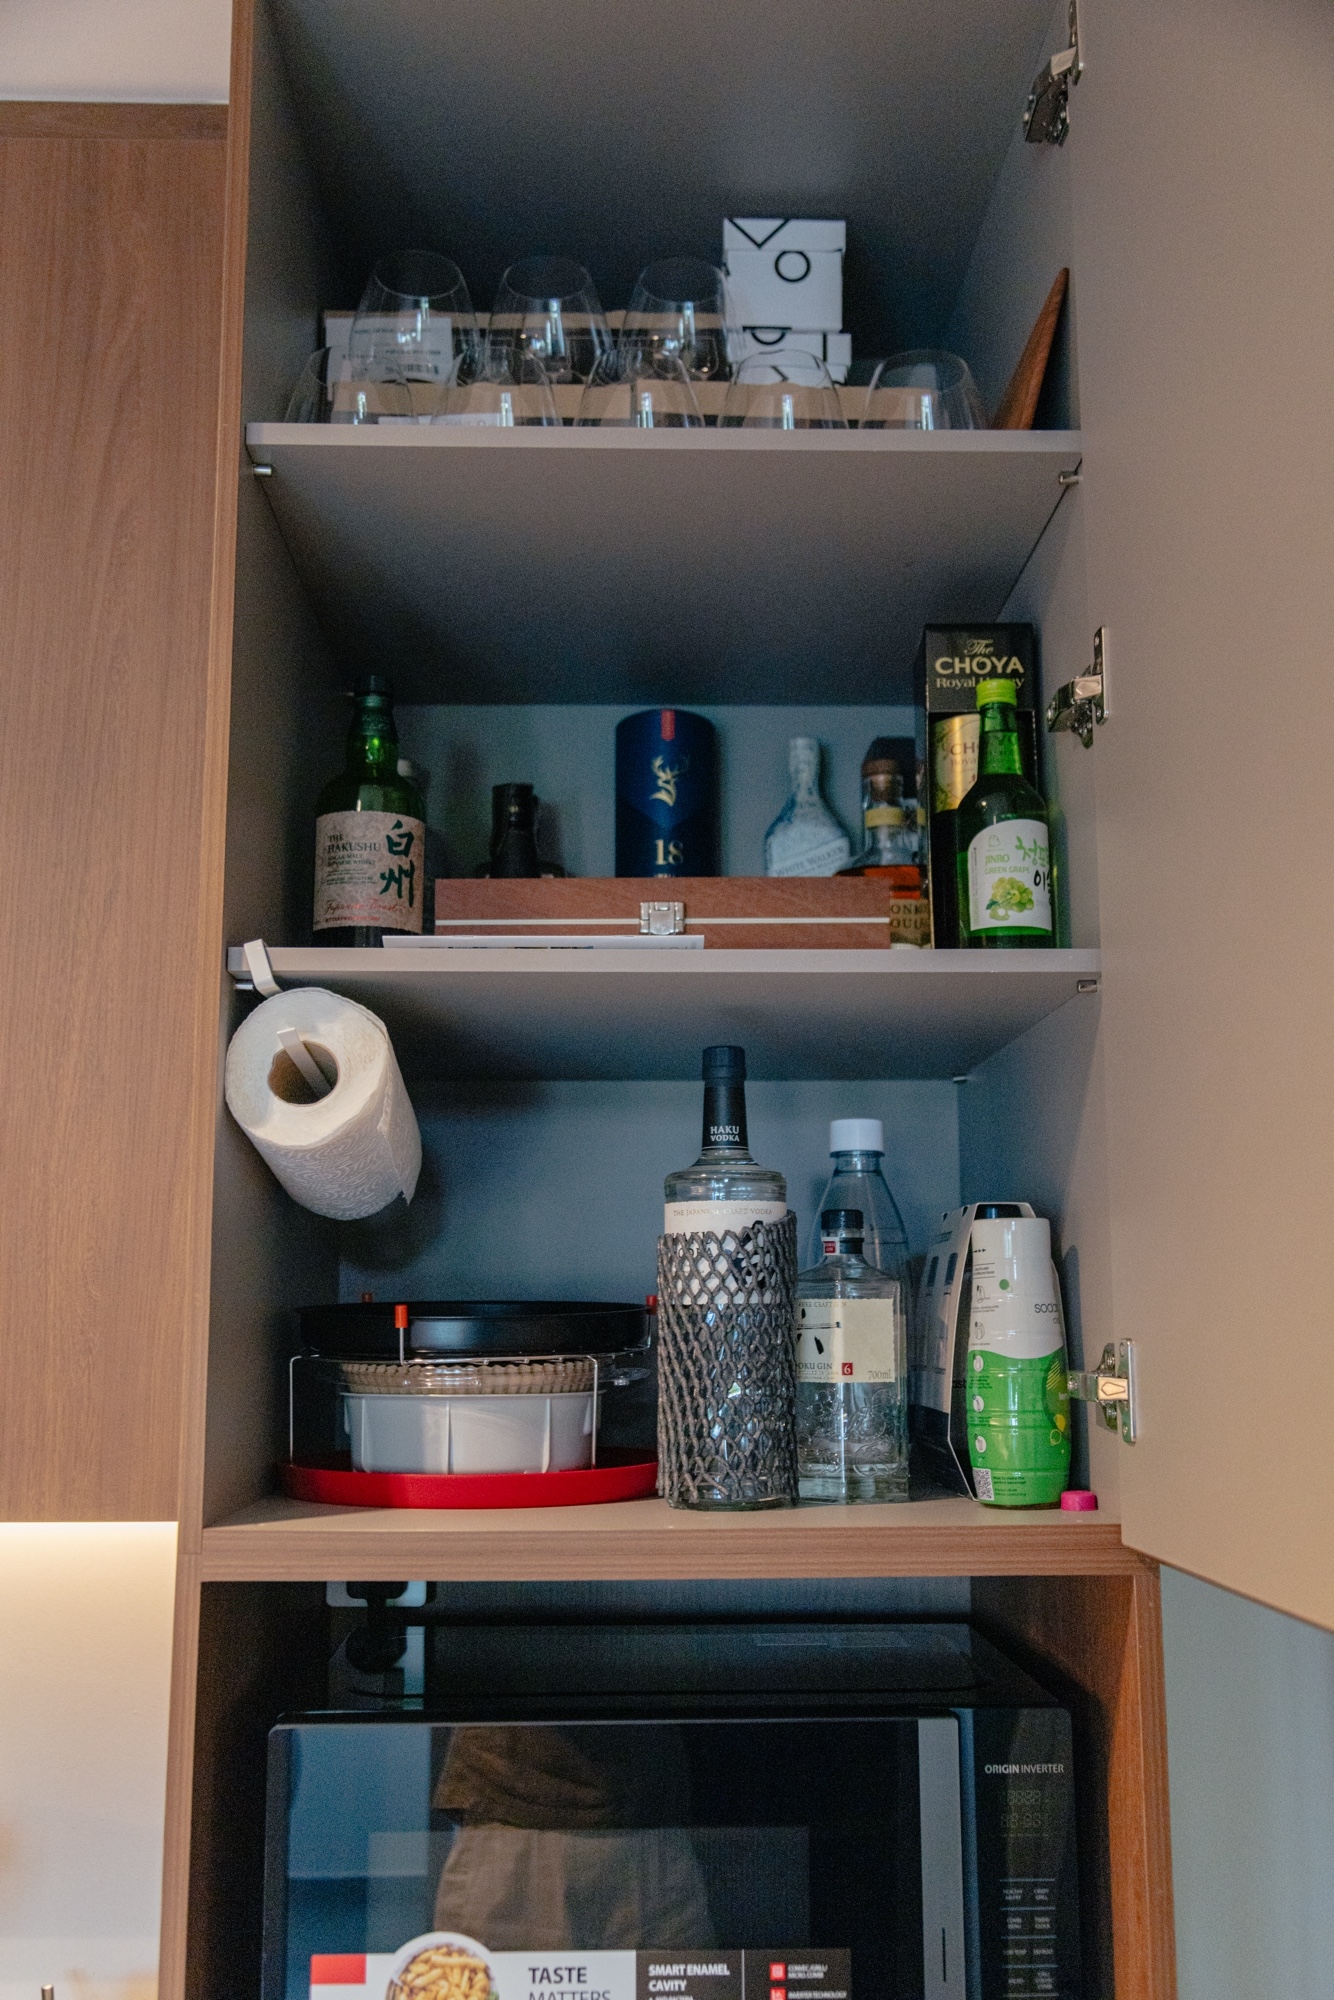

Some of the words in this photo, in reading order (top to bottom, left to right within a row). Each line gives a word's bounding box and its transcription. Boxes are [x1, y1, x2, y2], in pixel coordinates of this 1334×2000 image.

[965, 638, 994, 655] The
[935, 656, 1024, 675] CHOYA
[936, 676, 976, 690] Royal
[327, 842, 381, 854] HAKUSHU
[655, 838, 684, 866] 18
[379, 819, 415, 908] 白州
[985, 853, 1010, 866] JINRO
[710, 1125, 740, 1135] HAKU
[710, 1134, 740, 1142] VODKA
[750, 1207, 772, 1215] VODKA
[797, 1362, 815, 1370] OKU
[817, 1362, 833, 1370] GIN
[843, 1363, 852, 1375] 6
[984, 1763, 1020, 1774] ORIGIN
[1021, 1763, 1064, 1774] INVERTER
[528, 1966, 587, 1984] TASTE
[648, 1963, 686, 1977] SMART
[687, 1962, 730, 1976] ENAMEL
[648, 1980, 687, 1992] CAVITY
[529, 1990, 611, 2000] MATTERS
